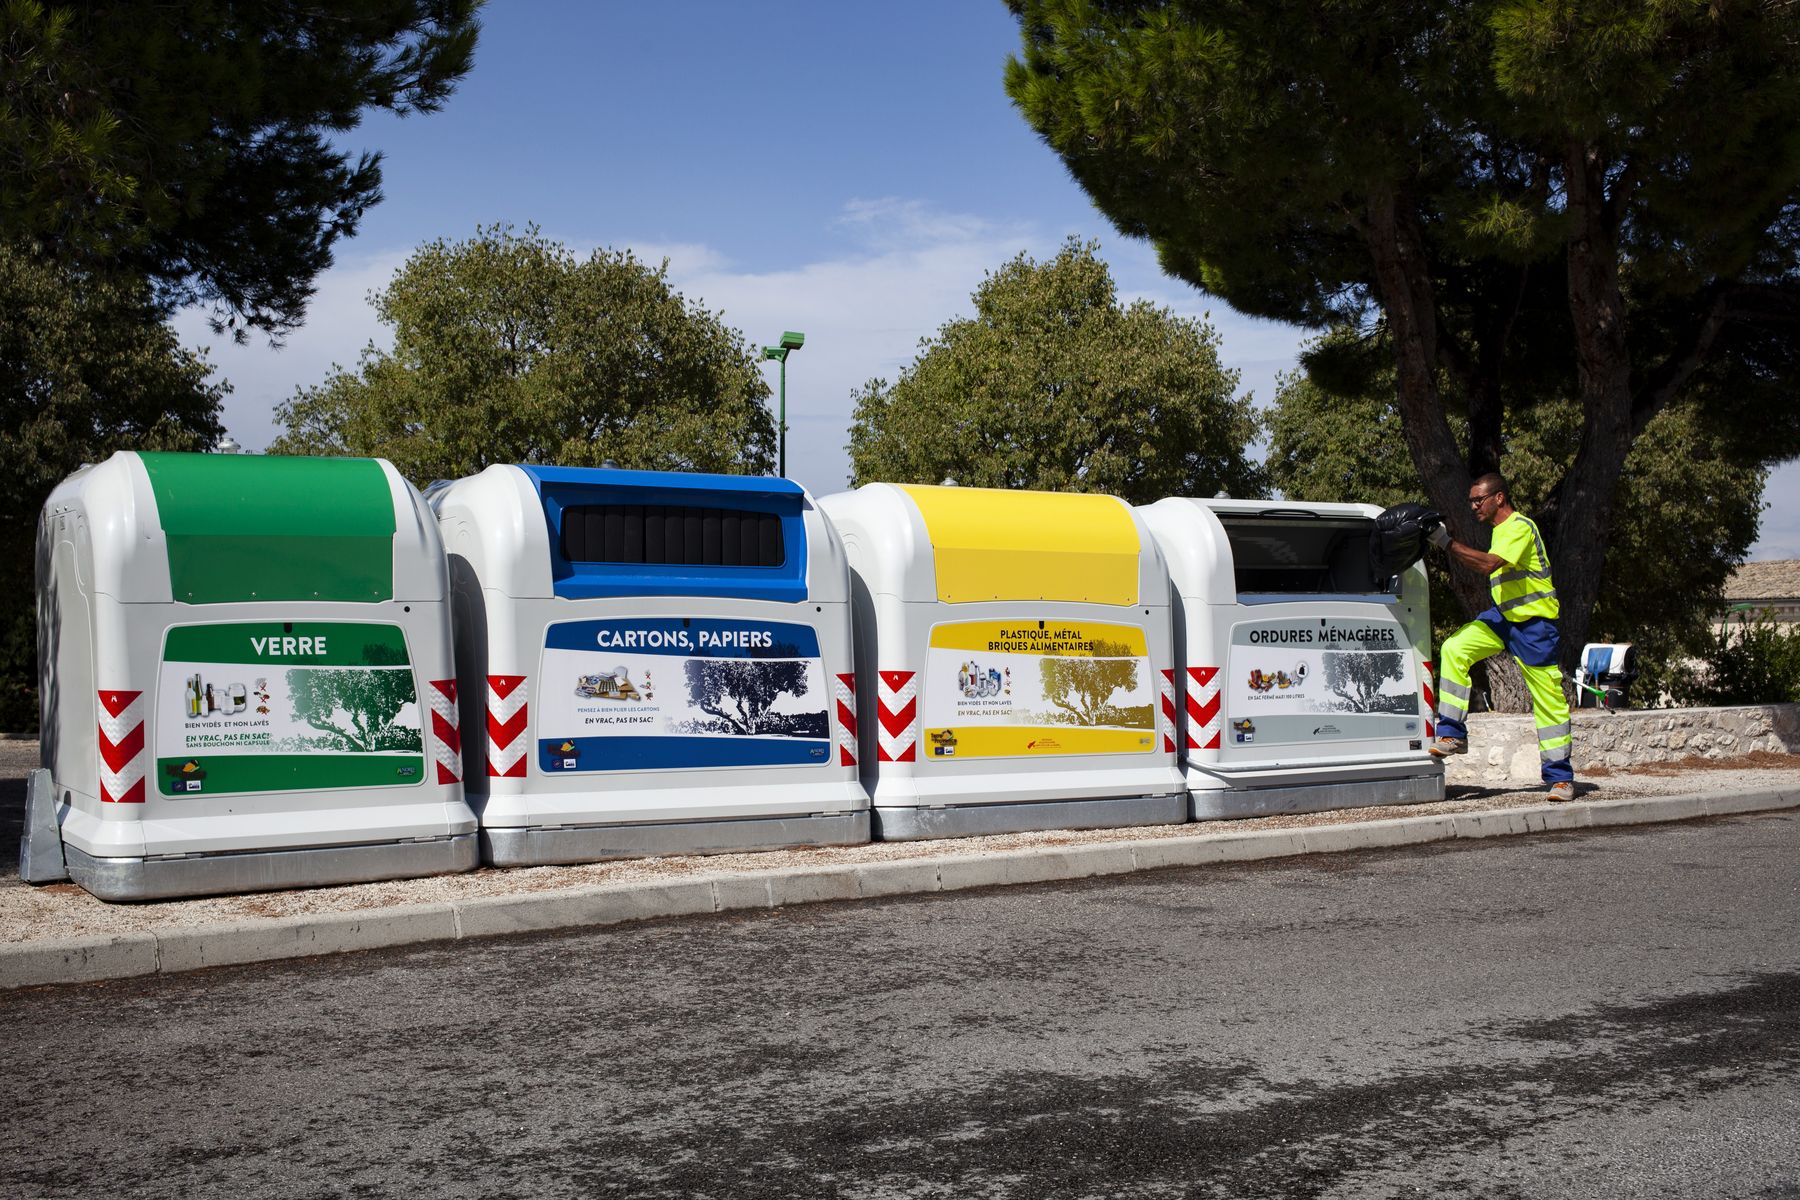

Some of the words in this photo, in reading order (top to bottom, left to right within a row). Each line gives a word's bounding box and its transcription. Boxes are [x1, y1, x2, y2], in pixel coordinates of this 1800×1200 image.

[597, 630, 695, 650] CARTONS,
[698, 630, 773, 648] PAPIERS
[1000, 629, 1052, 641] PLASTIQUE,
[1053, 628, 1082, 640] MÉTAL
[1249, 629, 1313, 643] ORDURES
[1318, 625, 1395, 642] MÉNAGÈRES
[250, 636, 327, 656] VERRE
[988, 641, 1028, 653] BRIQUES
[1029, 641, 1094, 651] ALIMENTAIRES
